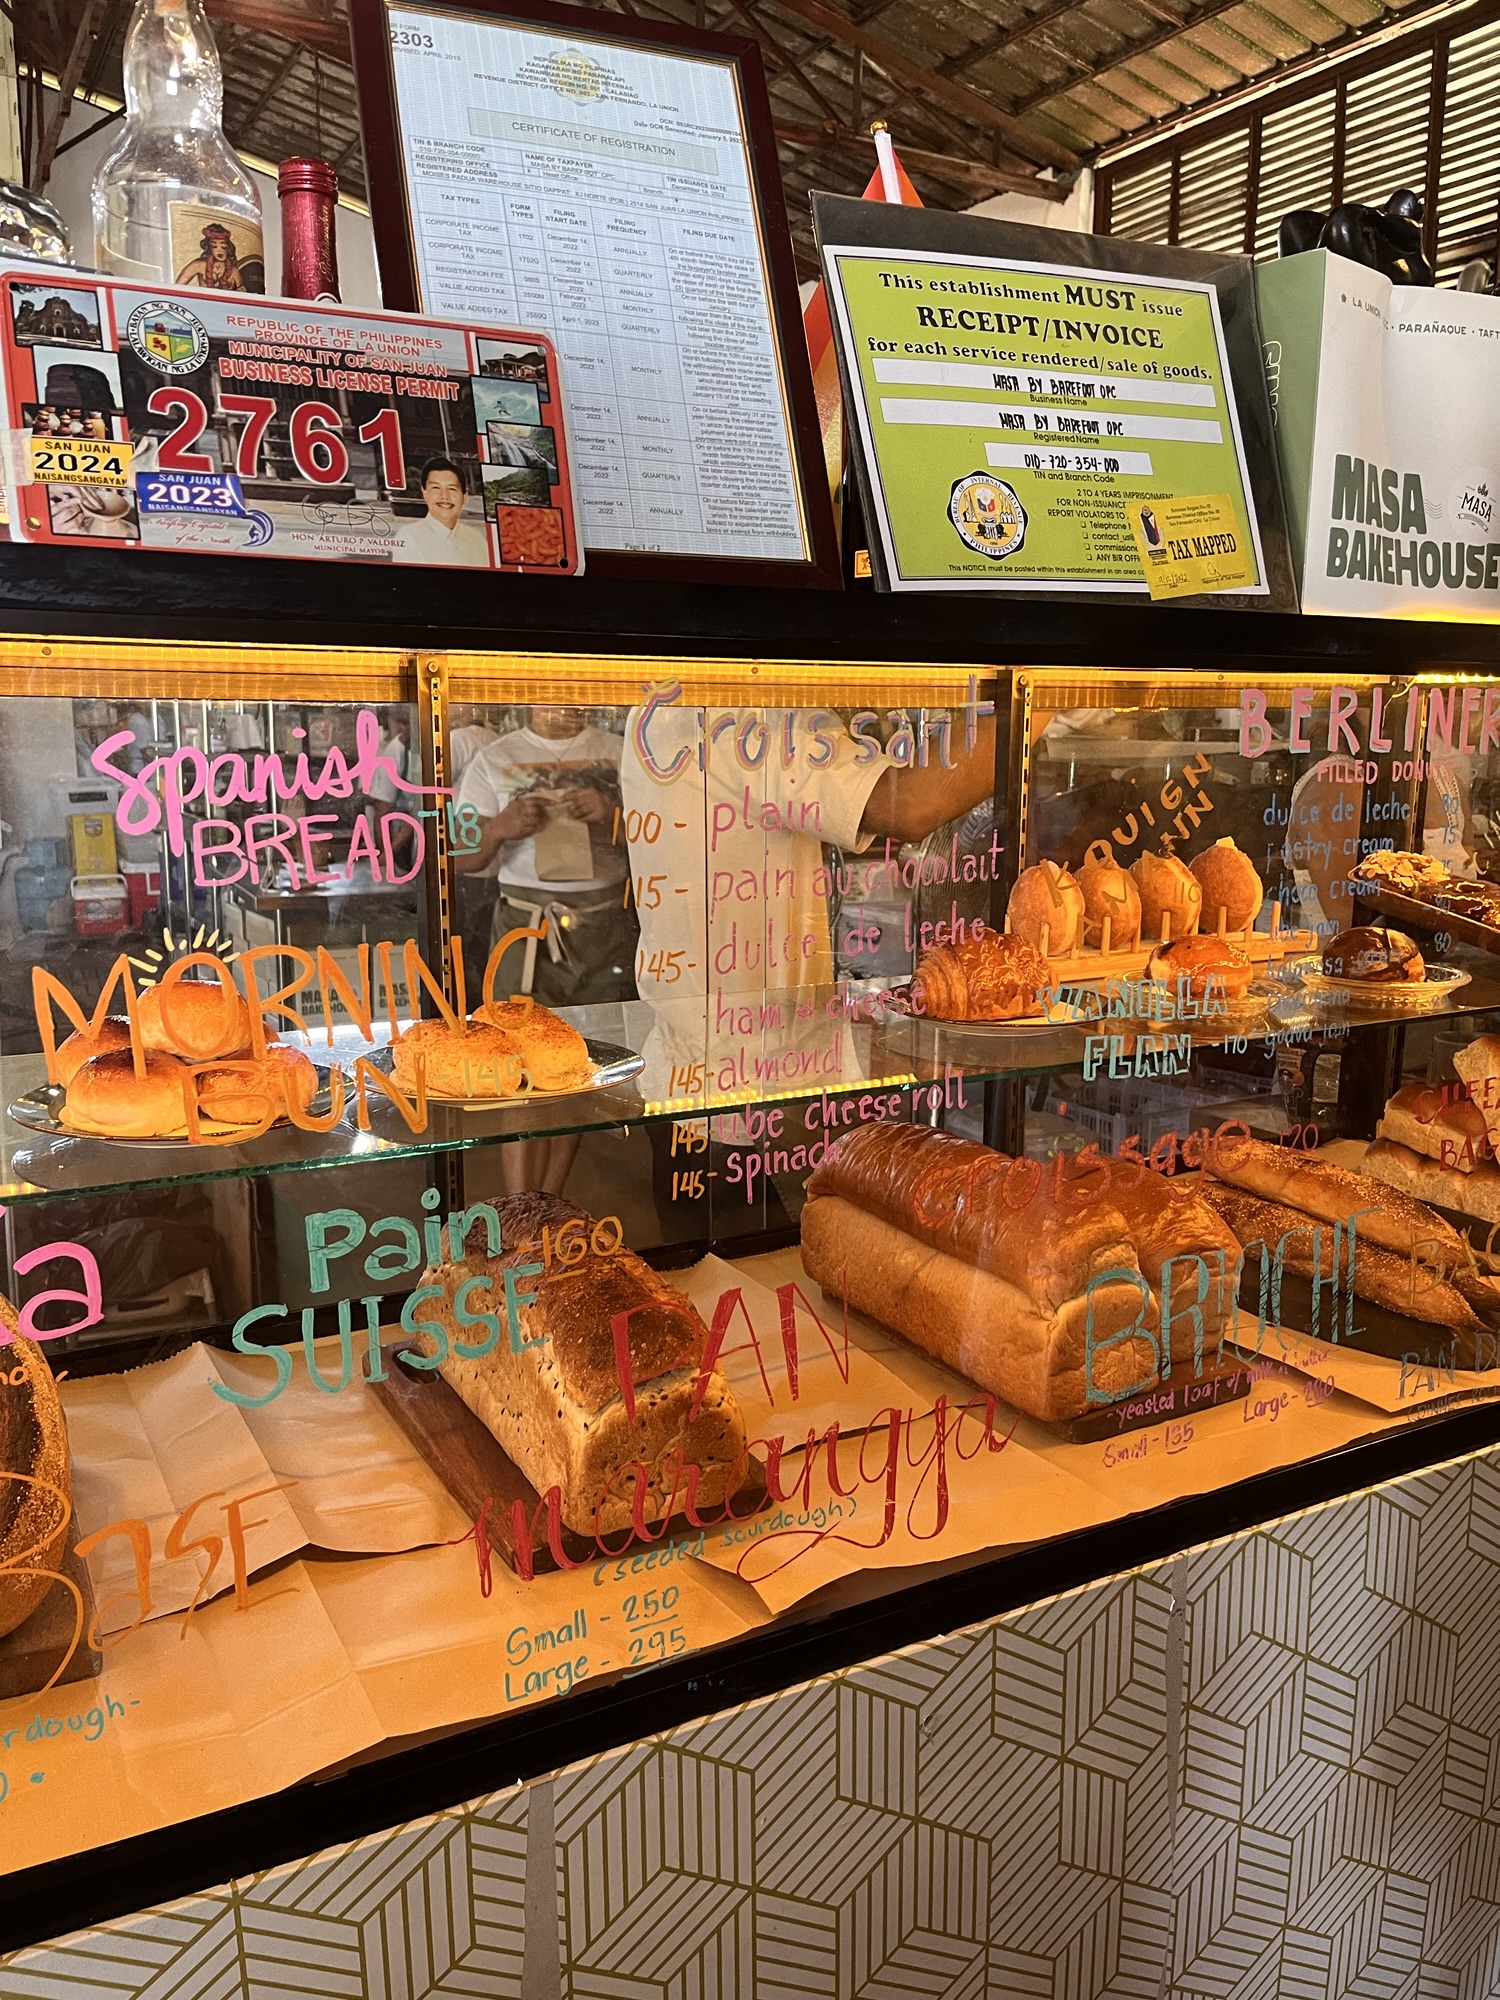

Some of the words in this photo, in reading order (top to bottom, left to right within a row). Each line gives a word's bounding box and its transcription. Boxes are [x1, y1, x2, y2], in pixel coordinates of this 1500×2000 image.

[391, 30, 434, 48] 2303
[511, 121, 582, 141] CERTIFICATE
[583, 132, 598, 143] OF
[600, 135, 676, 157] REGISTRATION
[510, 203, 531, 212] FORM
[511, 210, 535, 220] TYPES
[878, 272, 923, 291] This
[929, 277, 1060, 304] establishment
[1063, 284, 1136, 312] MUST
[1141, 299, 1184, 317] issue
[226, 315, 300, 334] REPUBLIC
[304, 324, 325, 337] OF
[327, 327, 364, 342] THE
[366, 331, 443, 350] PHILIPPINES
[916, 305, 1165, 350] RECEIPT/INVOICE
[1352, 297, 1363, 309] LA
[1398, 321, 1467, 336] PARAÑAQUE
[1478, 328, 1500, 340] TAFT
[228, 341, 341, 367] MUNICIPALITY
[345, 354, 366, 369] OF
[370, 356, 404, 373] SAN
[406, 361, 448, 379] JUAN
[254, 329, 328, 348] PROVINCE
[331, 336, 353, 350] OF
[355, 340, 376, 353] LA
[377, 342, 421, 358] UNION
[867, 337, 899, 352] for
[904, 340, 947, 357] each
[952, 346, 1016, 362] service
[1021, 349, 1138, 373] rendered/sale
[1142, 358, 1159, 375] of
[1163, 365, 1213, 381] goods.
[218, 357, 313, 387] BUSINESS
[316, 369, 394, 396] LICENSE
[396, 376, 460, 402] PERMIT
[1027, 376, 1043, 393] BY
[1049, 378, 1096, 398] BAREFOOT
[1099, 384, 1117, 399] OPC
[1029, 394, 1063, 405] Business
[1063, 396, 1088, 407] Name
[147, 386, 407, 490] 2761
[1033, 413, 1049, 431] BY
[1106, 420, 1124, 436] OPC
[1033, 432, 1077, 444] Registered
[1075, 434, 1100, 445] Name
[34, 451, 124, 476] 2024
[44, 440, 73, 452] SAN
[77, 443, 112, 455] JUAN
[34, 472, 128, 488] NAISANGSANGAYAN
[158, 473, 186, 485] SAN
[187, 475, 222, 487] JUAN
[1033, 470, 1046, 480] TIN
[1047, 472, 1063, 481] and
[1064, 472, 1092, 483] Branch
[1093, 474, 1115, 484] Code
[1082, 489, 1093, 498] TO
[1099, 490, 1122, 499] YEARS
[1122, 491, 1174, 500] IMPRISONMENT
[1331, 454, 1427, 535] MASA
[147, 482, 234, 508] 2023
[1056, 498, 1071, 506] FOR
[1460, 491, 1492, 523] MASA
[1047, 509, 1075, 518] REPORT
[1075, 510, 1115, 519] VIOLATORS
[1116, 511, 1126, 520] TO
[1089, 521, 1127, 531] Telephone
[313, 544, 357, 553] MUNICIPAL
[359, 547, 388, 555] MAYOR
[319, 535, 357, 545] ARTURO
[367, 538, 406, 548] VALDRIZ
[968, 538, 1019, 555] PHILIPPINES
[1096, 553, 1110, 562] ANY
[1112, 554, 1123, 562] BIR
[1167, 538, 1194, 561] TAX
[1191, 533, 1237, 558] MAPPED
[1326, 526, 1500, 590] BAKEHOUSE
[948, 564, 961, 572] This
[962, 564, 987, 572] NOTICE
[1004, 565, 1013, 573] be
[1014, 565, 1036, 574] posted
[1066, 566, 1107, 574] establishment
[632, 673, 995, 787] Croissant
[91, 709, 459, 857] Spanish
[1316, 758, 1379, 785] FILLED
[712, 776, 823, 853] plain
[1331, 792, 1355, 824] de
[1364, 789, 1412, 824] leche
[192, 812, 426, 890] BREAD
[1342, 835, 1395, 856] cream
[710, 849, 796, 925] pain
[812, 866, 855, 897] au
[1328, 878, 1382, 901] cream
[714, 917, 818, 976] dulce
[843, 906, 882, 958] de
[904, 900, 986, 953] leche
[32, 920, 549, 1086] MORNING
[715, 986, 787, 1035] ham
[825, 981, 928, 1022] cheese
[716, 1031, 843, 1092] almond
[1082, 1033, 1192, 1082] FLAN
[183, 1051, 429, 1146] BUN
[716, 1102, 786, 1144] ube
[803, 1087, 902, 1132] cheese
[911, 1072, 968, 1113] roll
[724, 1128, 842, 1205] spinach
[304, 1186, 503, 1293] Pain
[207, 1262, 553, 1409] SUISSE
[611, 1269, 850, 1423] PAN
[1242, 1391, 1290, 1423] Large
[592, 1530, 706, 1588] (seeded
[505, 1607, 589, 1667] Small
[622, 1585, 681, 1624] 250
[504, 1653, 591, 1704] Large
[627, 1625, 688, 1667] 295
